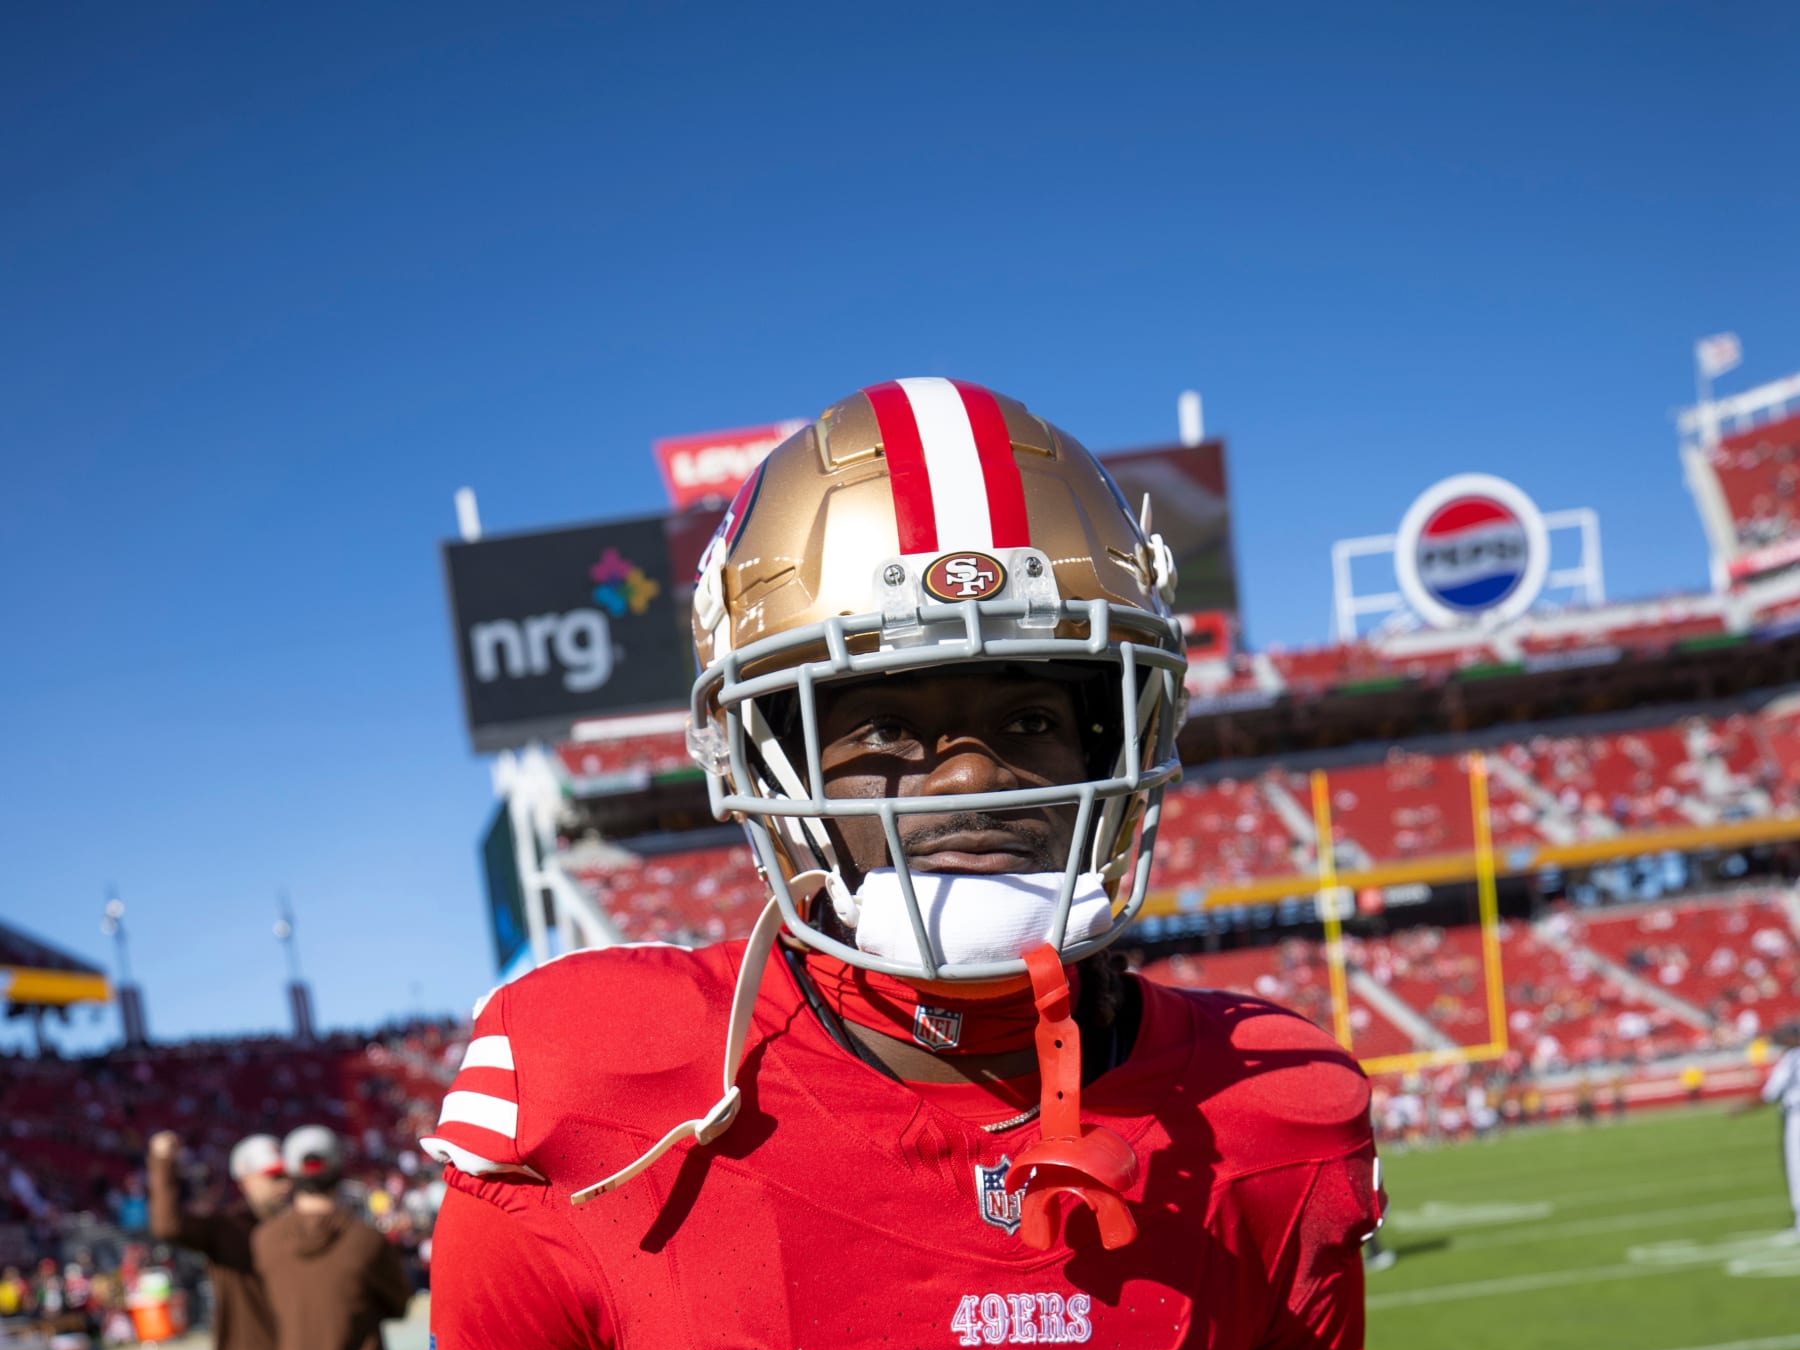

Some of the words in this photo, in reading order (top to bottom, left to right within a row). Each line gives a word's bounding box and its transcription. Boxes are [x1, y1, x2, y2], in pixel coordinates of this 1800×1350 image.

[945, 558, 994, 596] SF
[471, 609, 613, 692] nrg
[919, 1015, 955, 1045] NFL
[951, 1293, 1092, 1346] 49ERS
